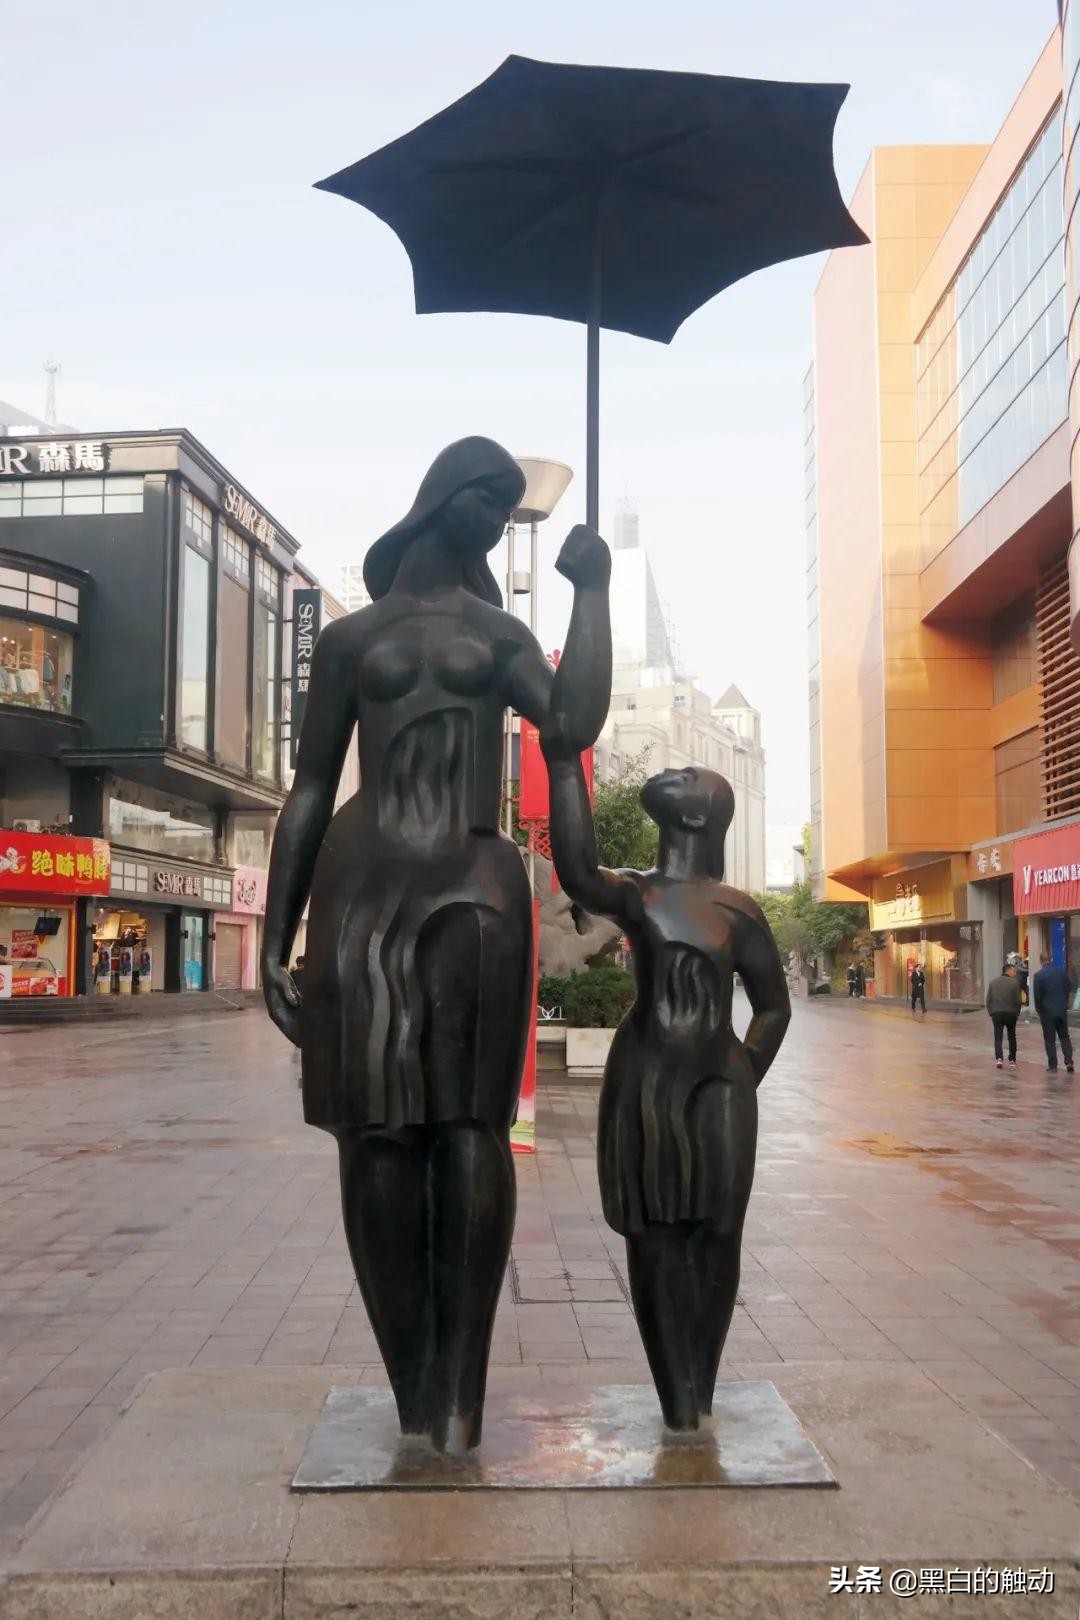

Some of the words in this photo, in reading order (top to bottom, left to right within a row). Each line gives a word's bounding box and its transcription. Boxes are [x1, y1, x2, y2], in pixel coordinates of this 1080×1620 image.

[225, 484, 257, 534] SEMIR
[298, 603, 314, 659] SEMIR
[31, 849, 107, 880] 绝味鸭脖
[1034, 866, 1069, 886] YEARCON
[157, 871, 184, 895] SEMIR
